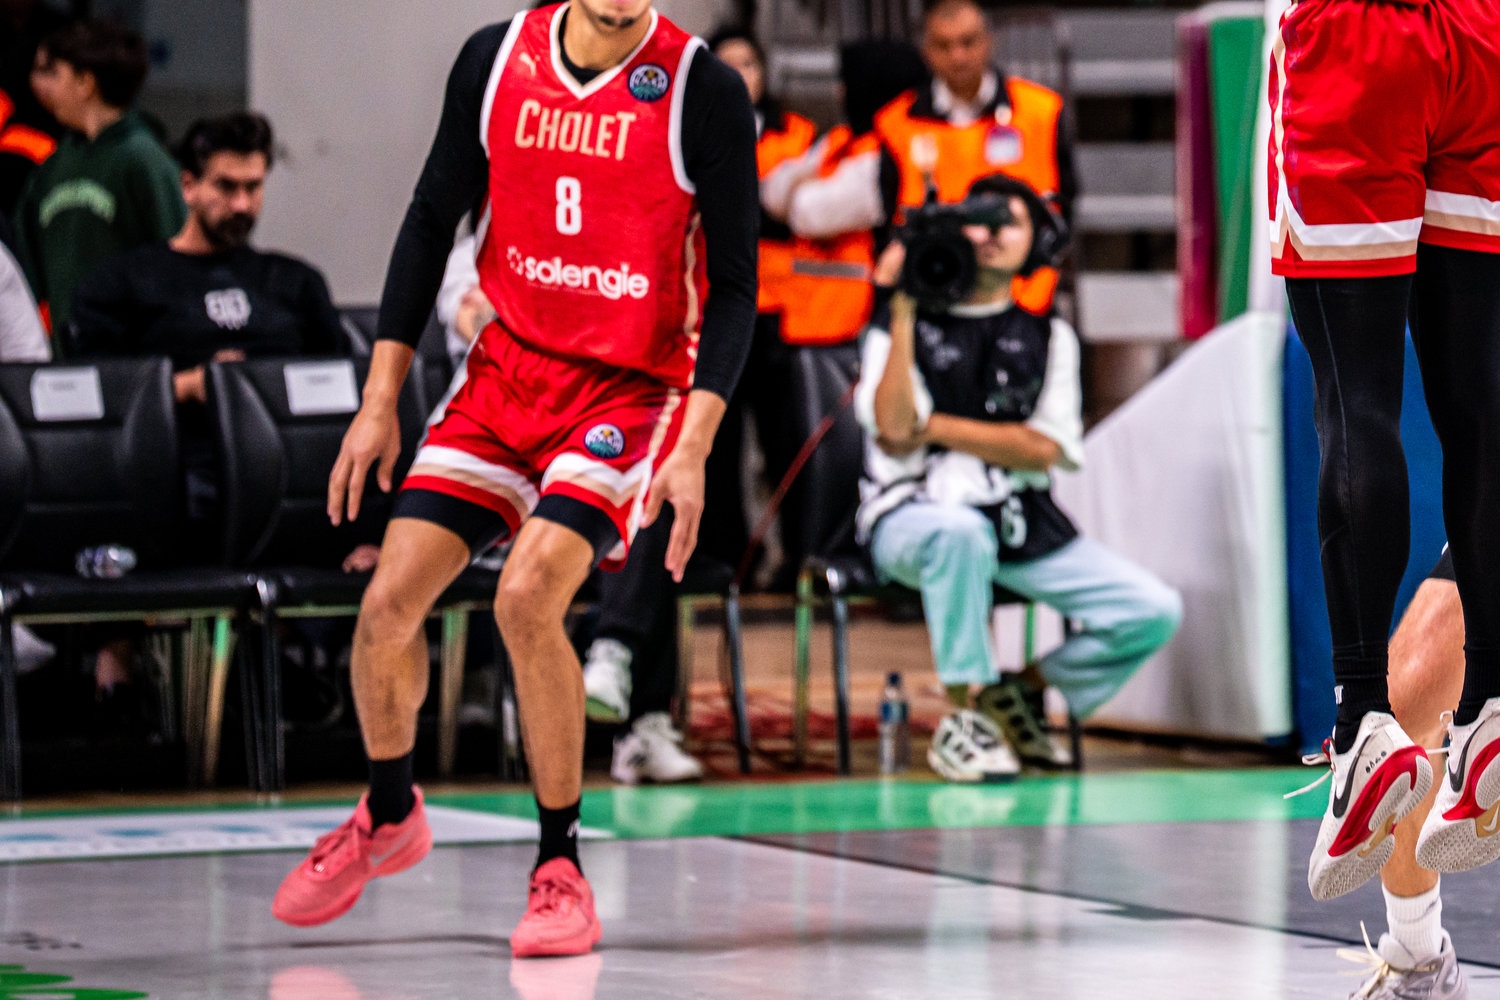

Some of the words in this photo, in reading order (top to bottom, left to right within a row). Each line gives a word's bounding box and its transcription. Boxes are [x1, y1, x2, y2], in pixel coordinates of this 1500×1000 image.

[514, 99, 637, 161] CHOLET
[555, 176, 582, 236] 8
[524, 256, 650, 300] solengie
